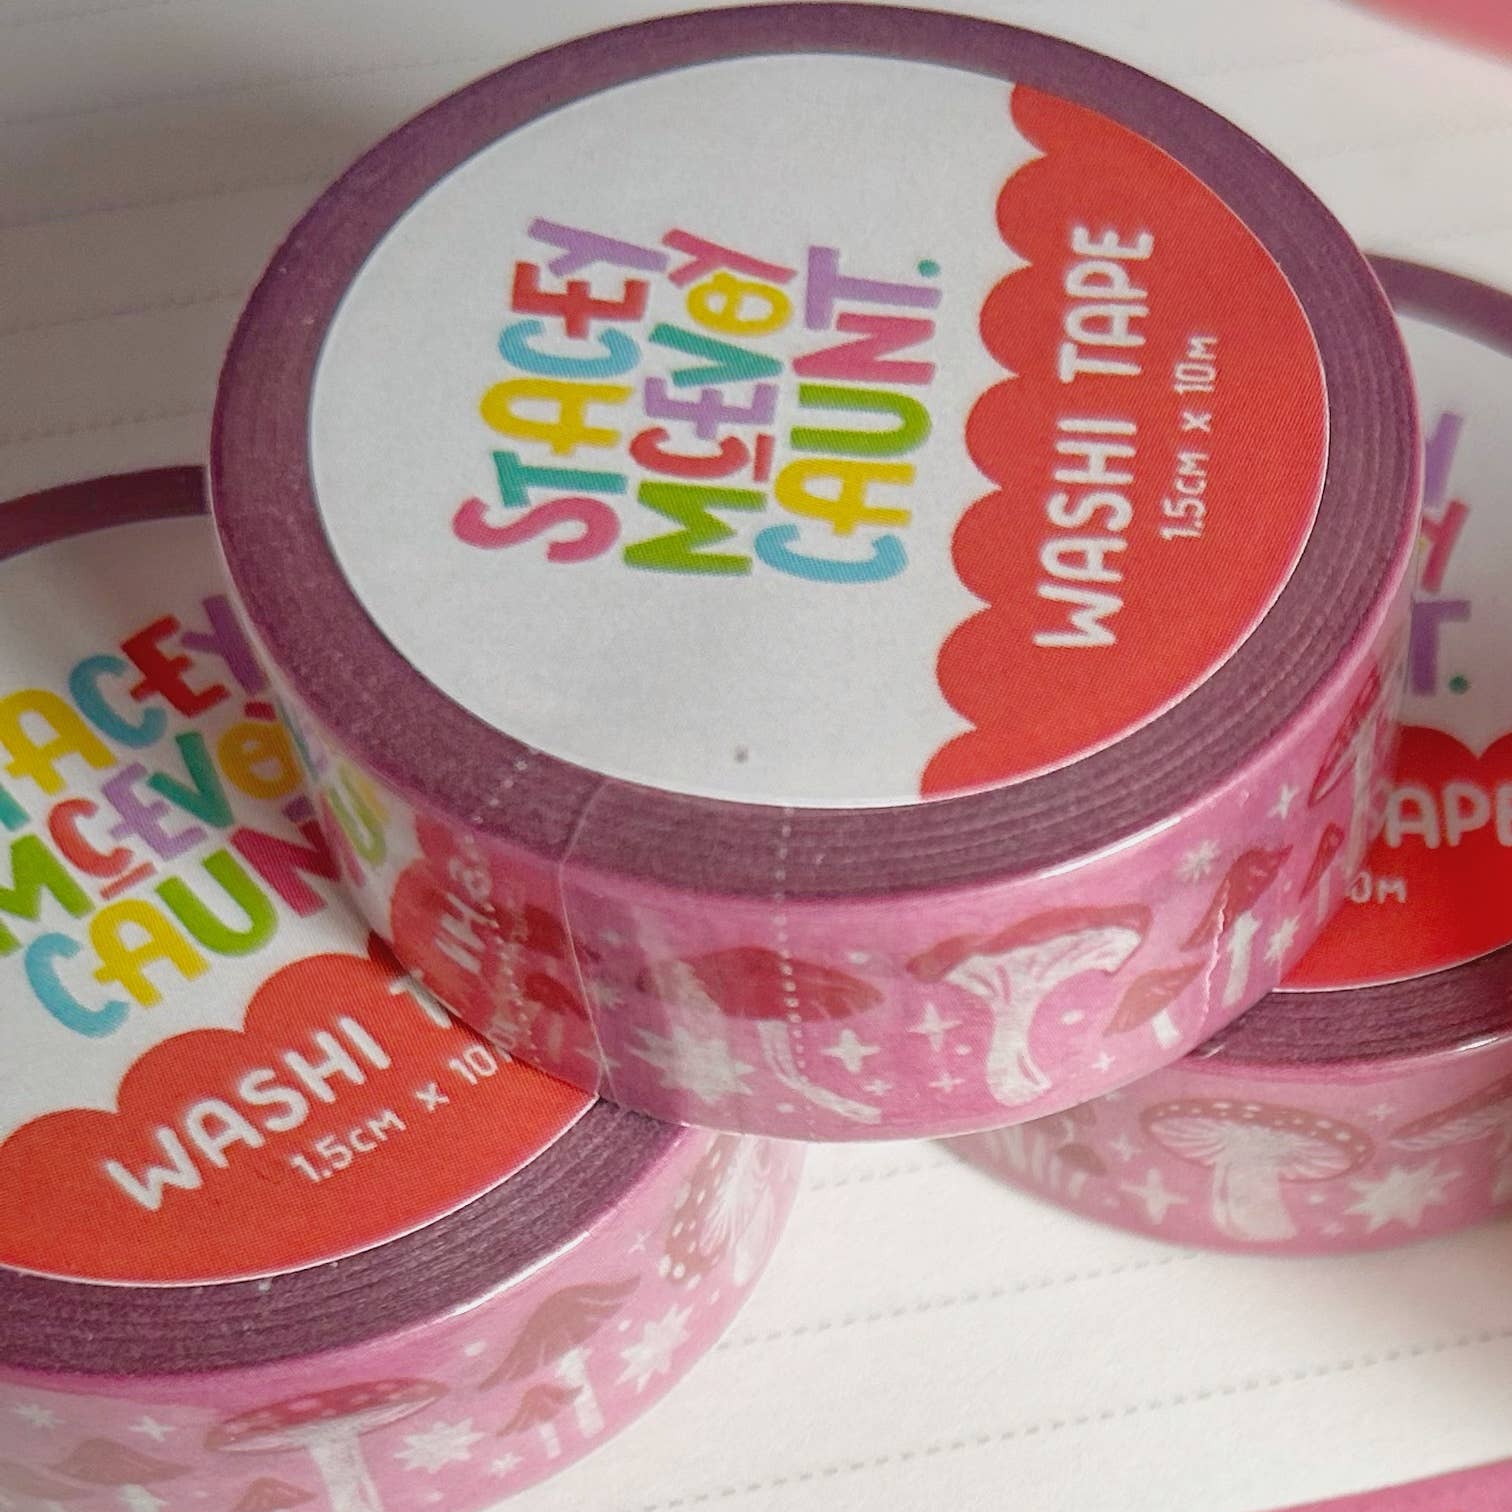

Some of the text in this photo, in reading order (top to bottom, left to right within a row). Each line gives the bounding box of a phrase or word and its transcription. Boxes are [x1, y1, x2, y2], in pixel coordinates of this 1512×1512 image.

[452, 217, 669, 564] STACEY
[754, 246, 942, 584] CAUNT.
[1033, 226, 1155, 648] WASHI TAPE
[0, 594, 270, 832] ACEY
[24, 796, 342, 1038] CAUN
[101, 1015, 394, 1212] WASHI
[448, 1043, 512, 1085] 10
